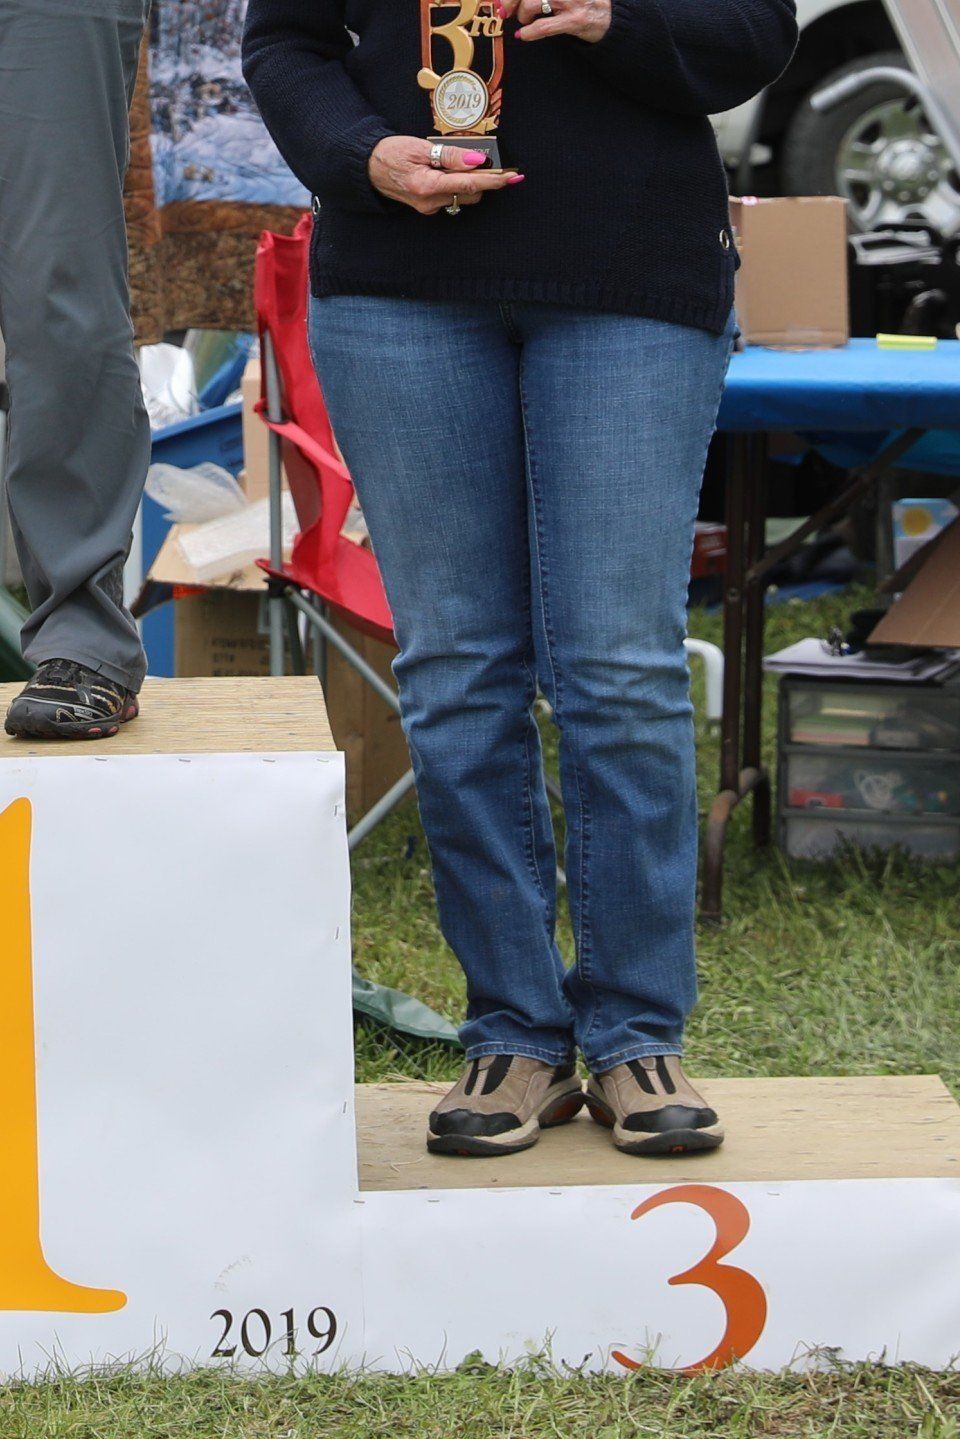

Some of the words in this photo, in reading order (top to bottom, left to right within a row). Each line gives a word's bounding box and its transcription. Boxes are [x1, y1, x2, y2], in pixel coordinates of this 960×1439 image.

[447, 92, 482, 110] 2019
[611, 1184, 769, 1378] 3
[209, 1306, 338, 1358] 2019
